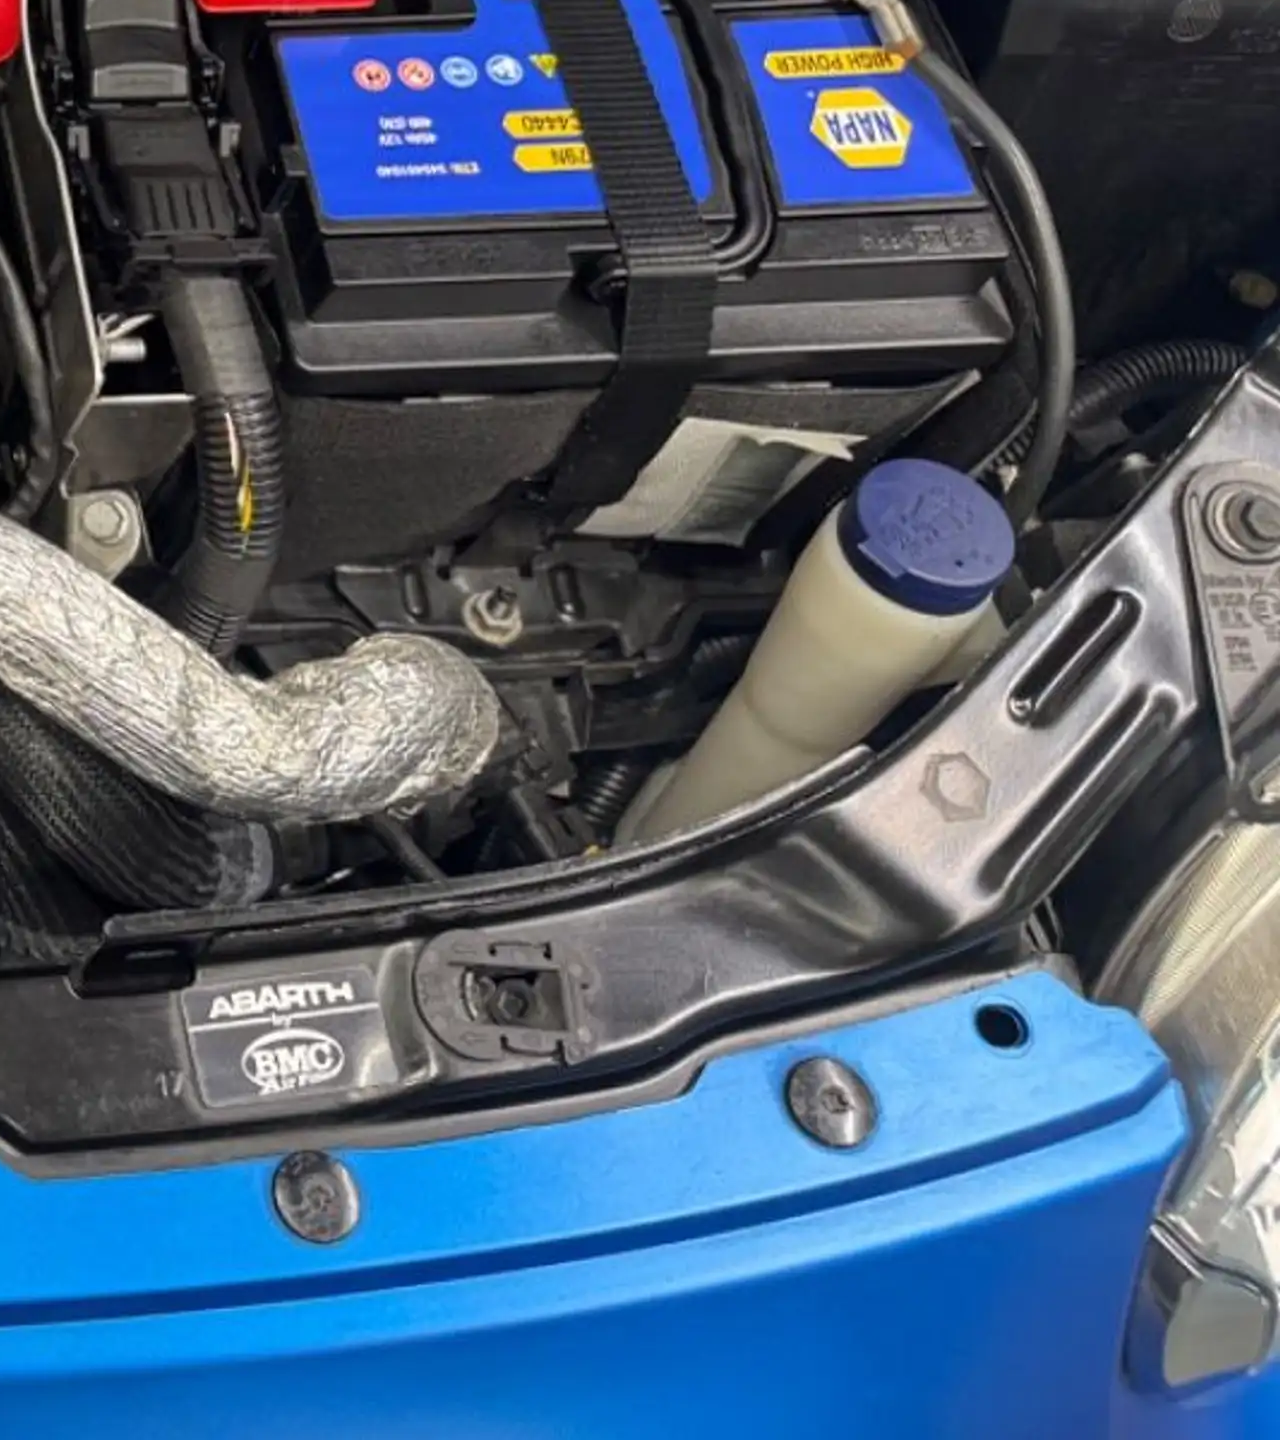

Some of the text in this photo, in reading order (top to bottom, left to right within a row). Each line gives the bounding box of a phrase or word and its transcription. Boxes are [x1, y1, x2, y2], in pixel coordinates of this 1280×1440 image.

[774, 51, 894, 75] HIGH POWER
[822, 110, 899, 146] NAPA
[208, 981, 355, 1020] ABARTH
[251, 1041, 336, 1079] BMC
